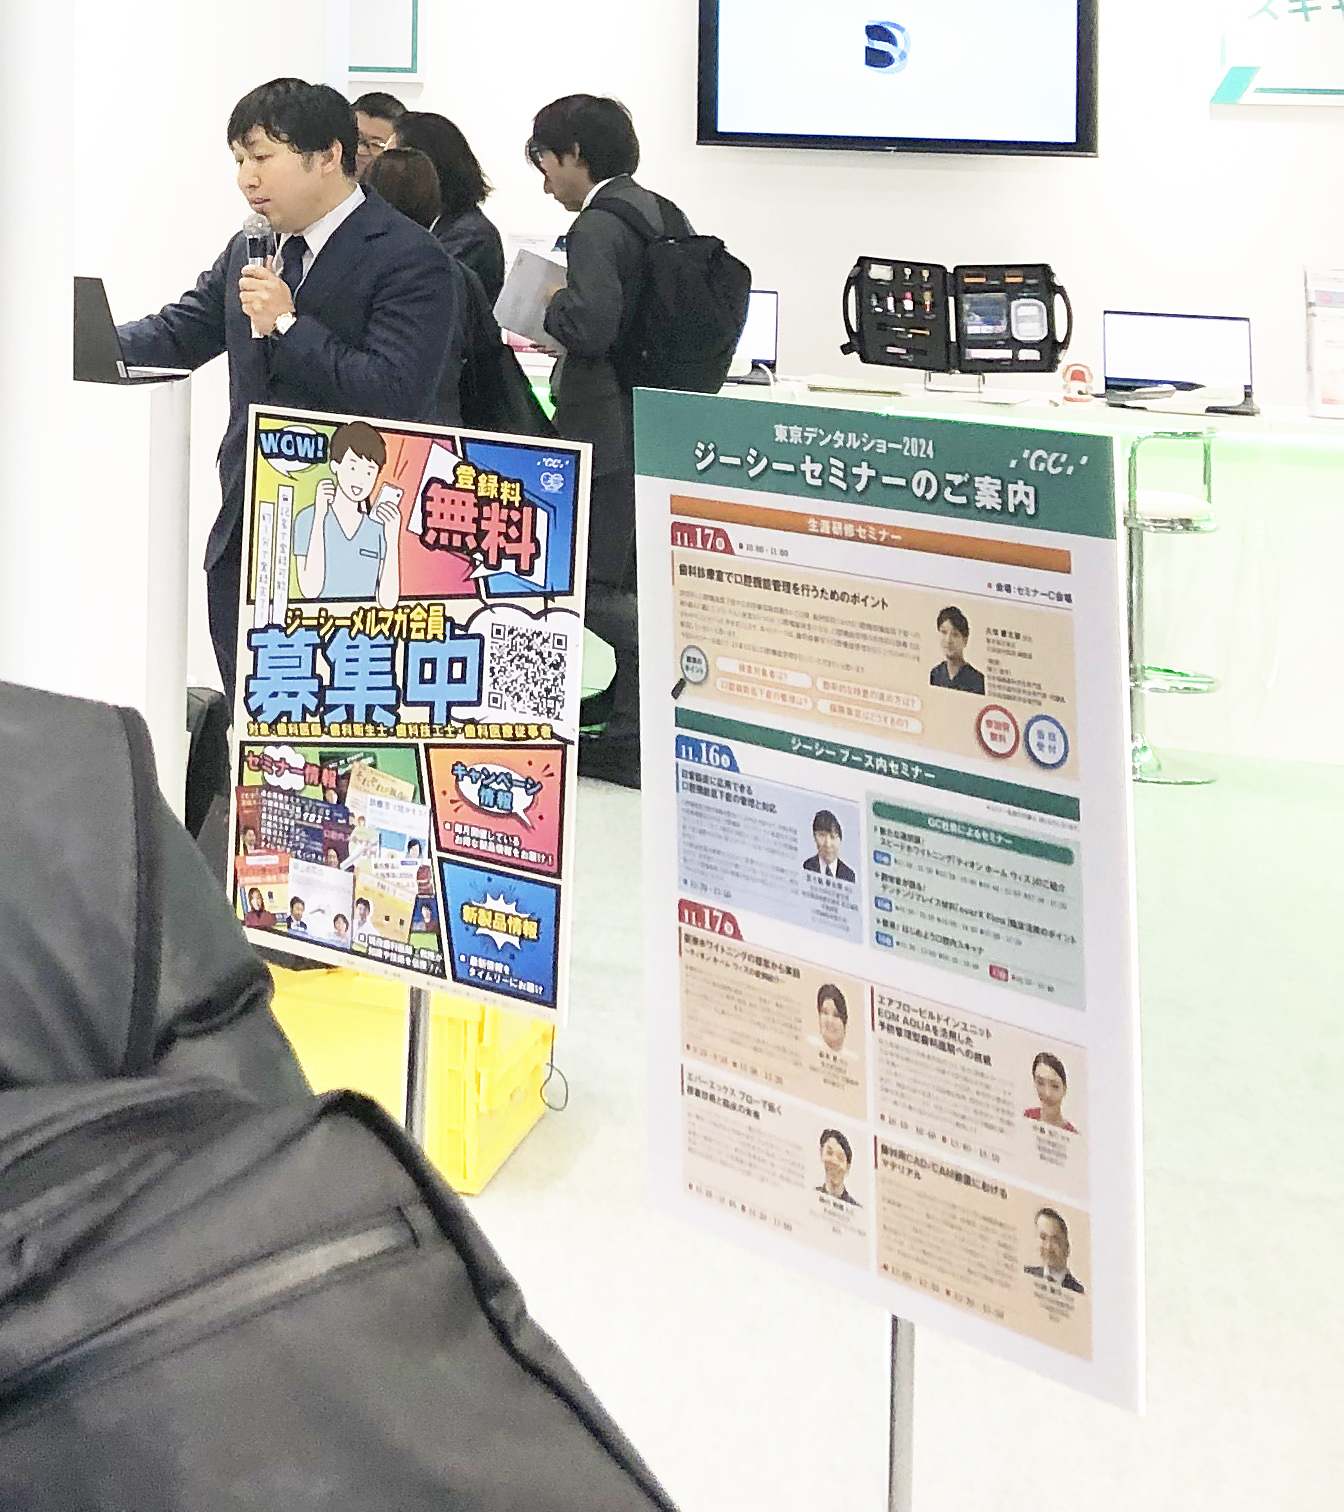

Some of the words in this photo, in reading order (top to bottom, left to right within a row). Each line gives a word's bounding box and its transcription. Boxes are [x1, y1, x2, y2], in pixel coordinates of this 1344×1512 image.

[259, 431, 325, 459] WOW!
[773, 422, 934, 459] 東京デンタルショー2024
[693, 440, 1038, 516] ジーシーセミナーのご案内
[1023, 448, 1076, 475] GC
[455, 464, 522, 508] 登録料
[424, 482, 536, 571] 無料
[806, 516, 902, 543] 生涯研修セミナー
[678, 563, 889, 611] 歯科診療室で口腔機能管理を行うためのポイント
[285, 602, 444, 640] ジーシーメルマガ会員
[246, 624, 483, 726] 募集中
[245, 750, 338, 789] セミナー情報
[451, 761, 543, 796] キャンペーン
[479, 787, 514, 812] 情報
[462, 904, 539, 940] 新製品情報
